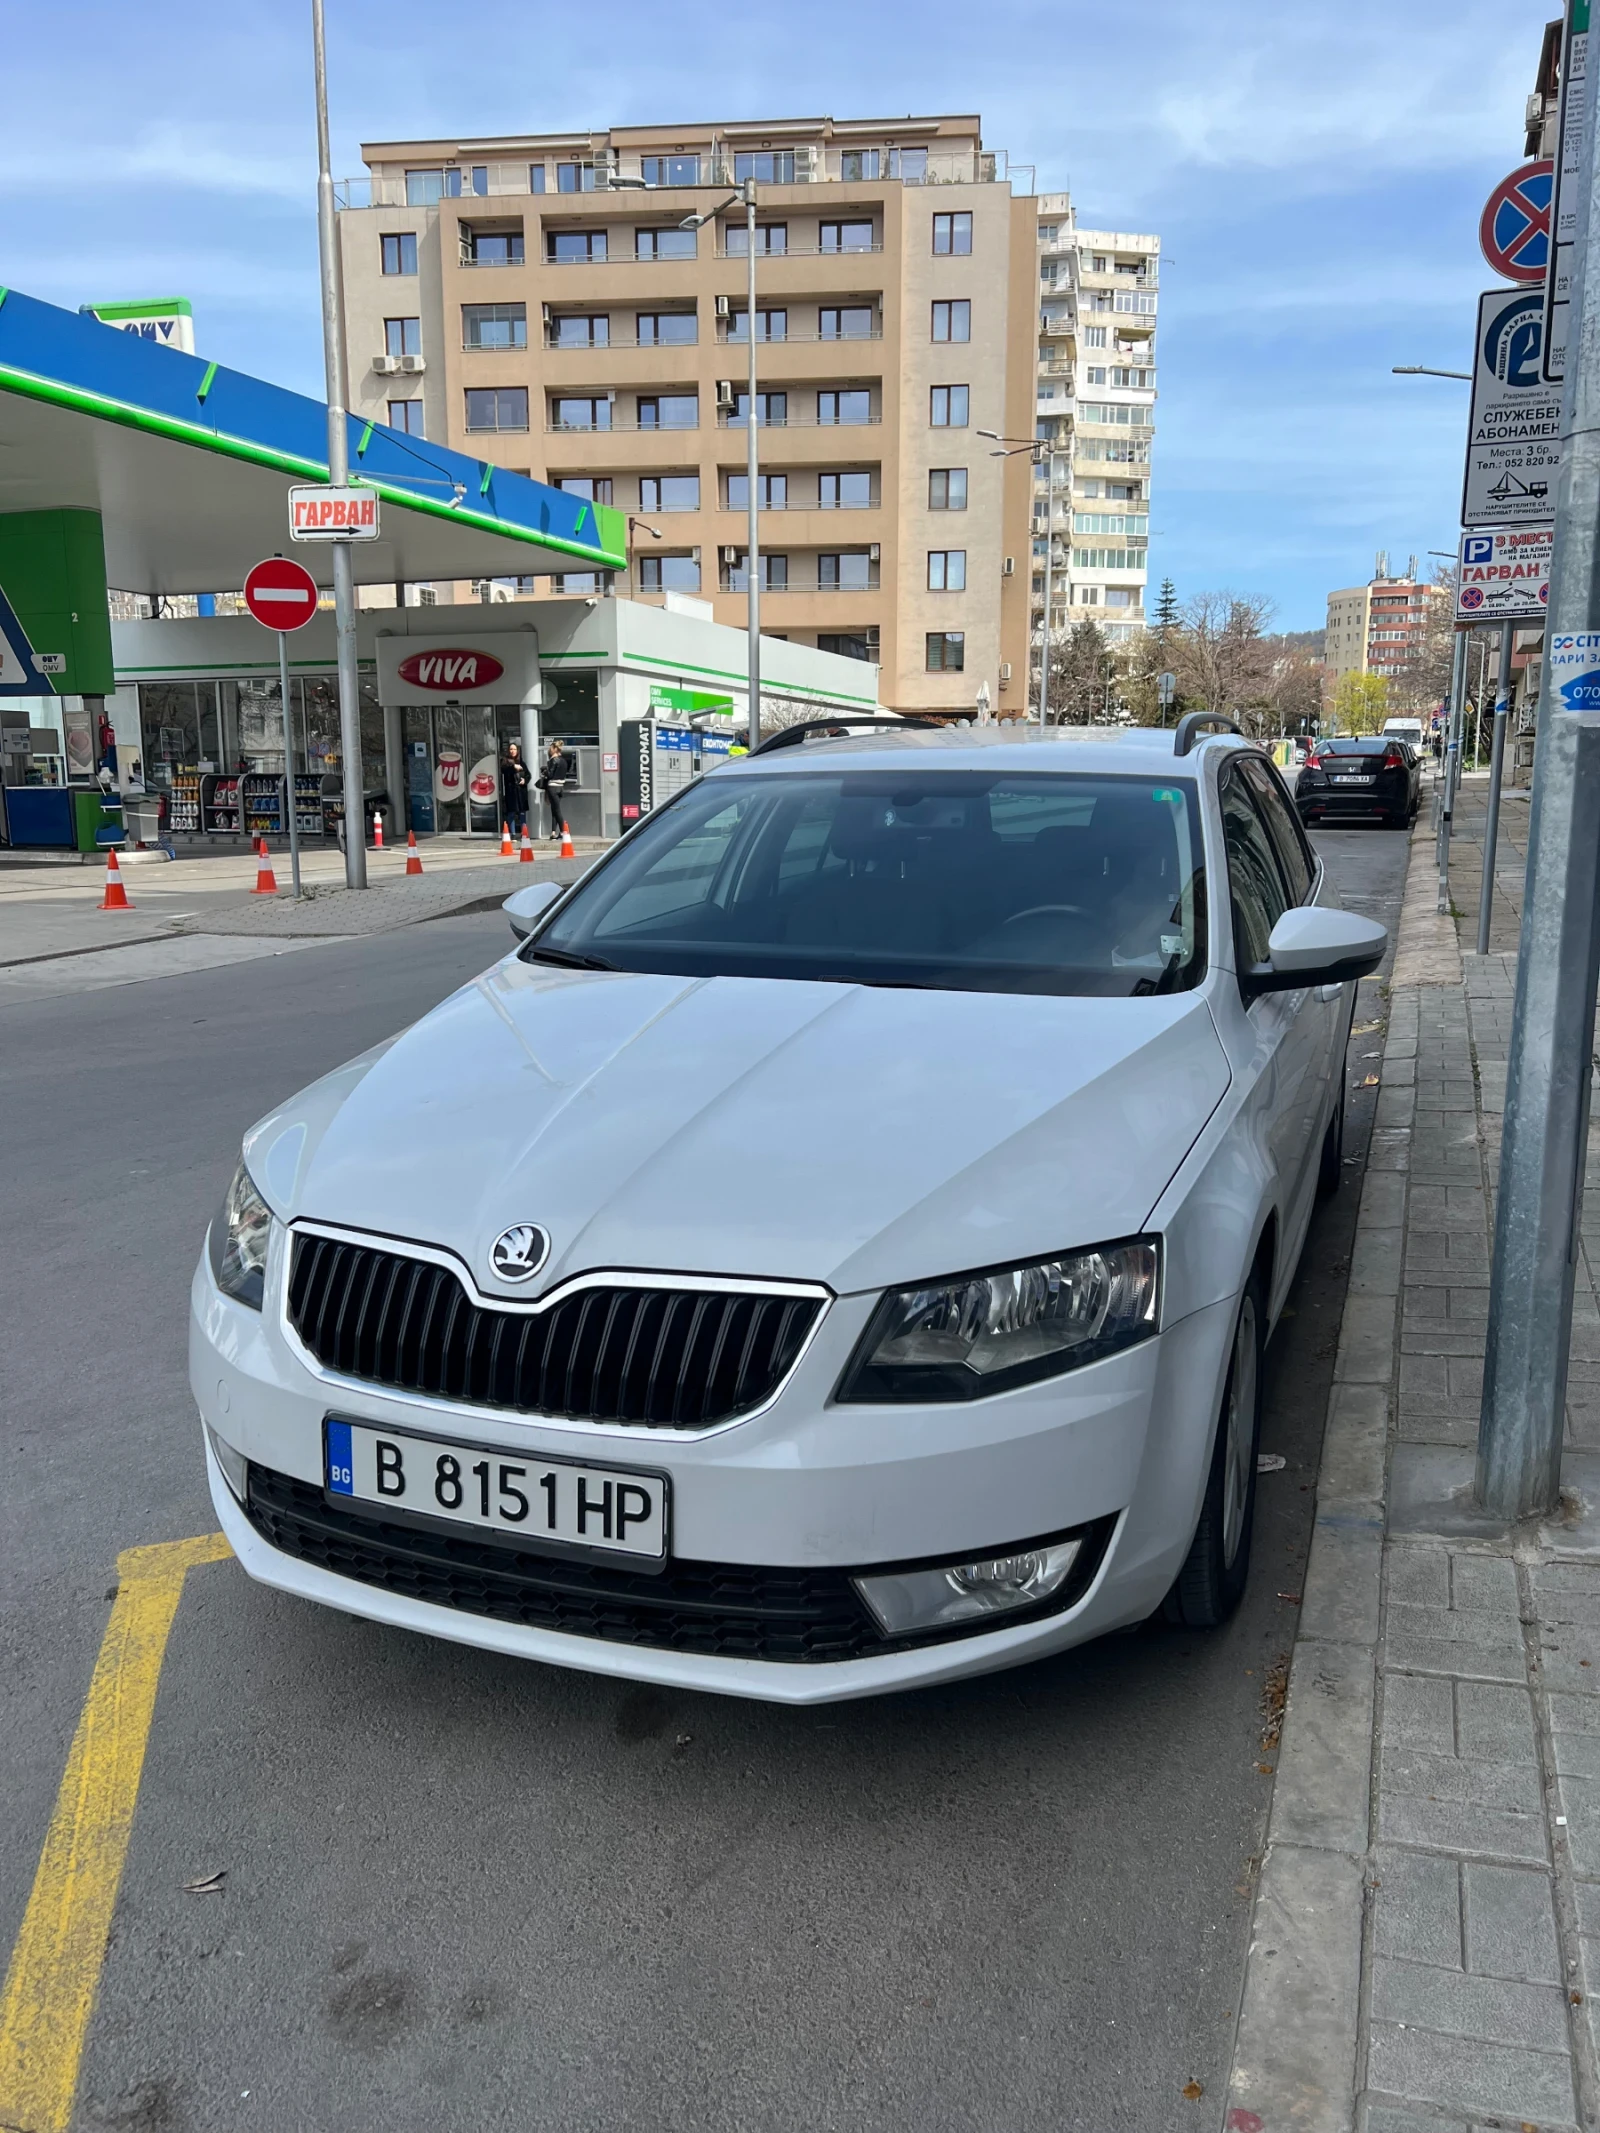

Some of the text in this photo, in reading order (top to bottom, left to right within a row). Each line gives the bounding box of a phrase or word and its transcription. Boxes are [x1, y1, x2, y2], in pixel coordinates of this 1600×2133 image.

[1504, 312, 1534, 338] ВАРНА
[1476, 423, 1559, 440] АБОНАМЕН
[1490, 444, 1552, 458] Места: 3 бр.
[1477, 456, 1560, 470] Тел.: 052 820 92
[294, 500, 374, 526] ГАРВАН
[1486, 502, 1536, 510] НАРУШИТЕЛИТЕ
[1494, 532, 1553, 548] 3 МЕСТ
[1462, 563, 1540, 582] ГАРВАН
[72, 612, 78, 622] 2
[419, 656, 477, 683] VIVA
[639, 724, 650, 812] ЕКОНТОМАТ
[332, 1466, 350, 1484] BG
[376, 1439, 652, 1540] B 8151 HP
